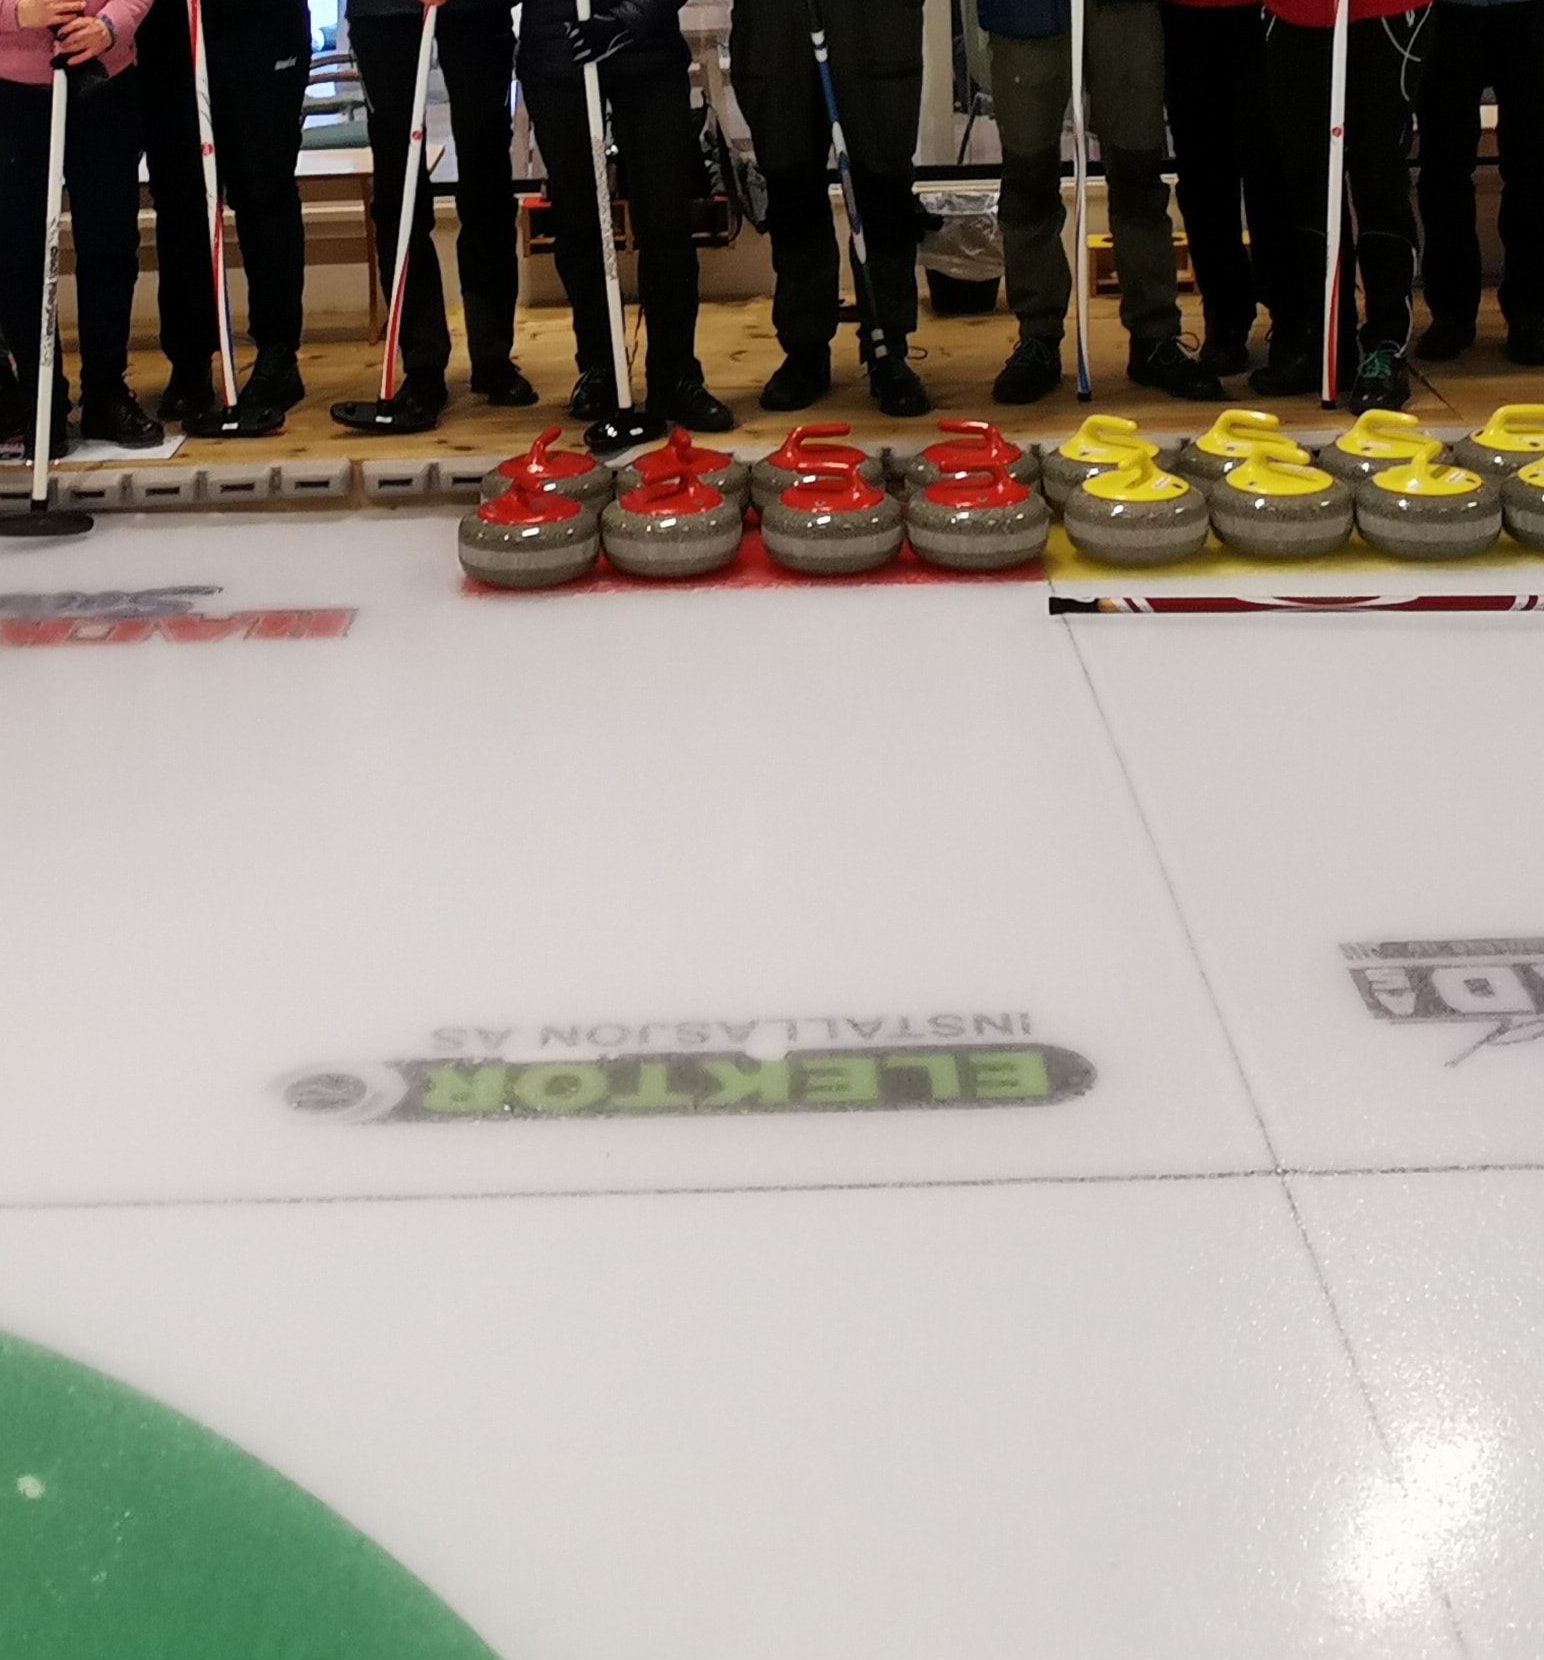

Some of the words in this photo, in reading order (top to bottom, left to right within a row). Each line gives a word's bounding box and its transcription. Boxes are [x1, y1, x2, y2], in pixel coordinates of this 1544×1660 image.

[431, 1027, 516, 1053] AS
[539, 1011, 1034, 1049] INSTALLASJON
[418, 1050, 1053, 1115] ELEKTOR
